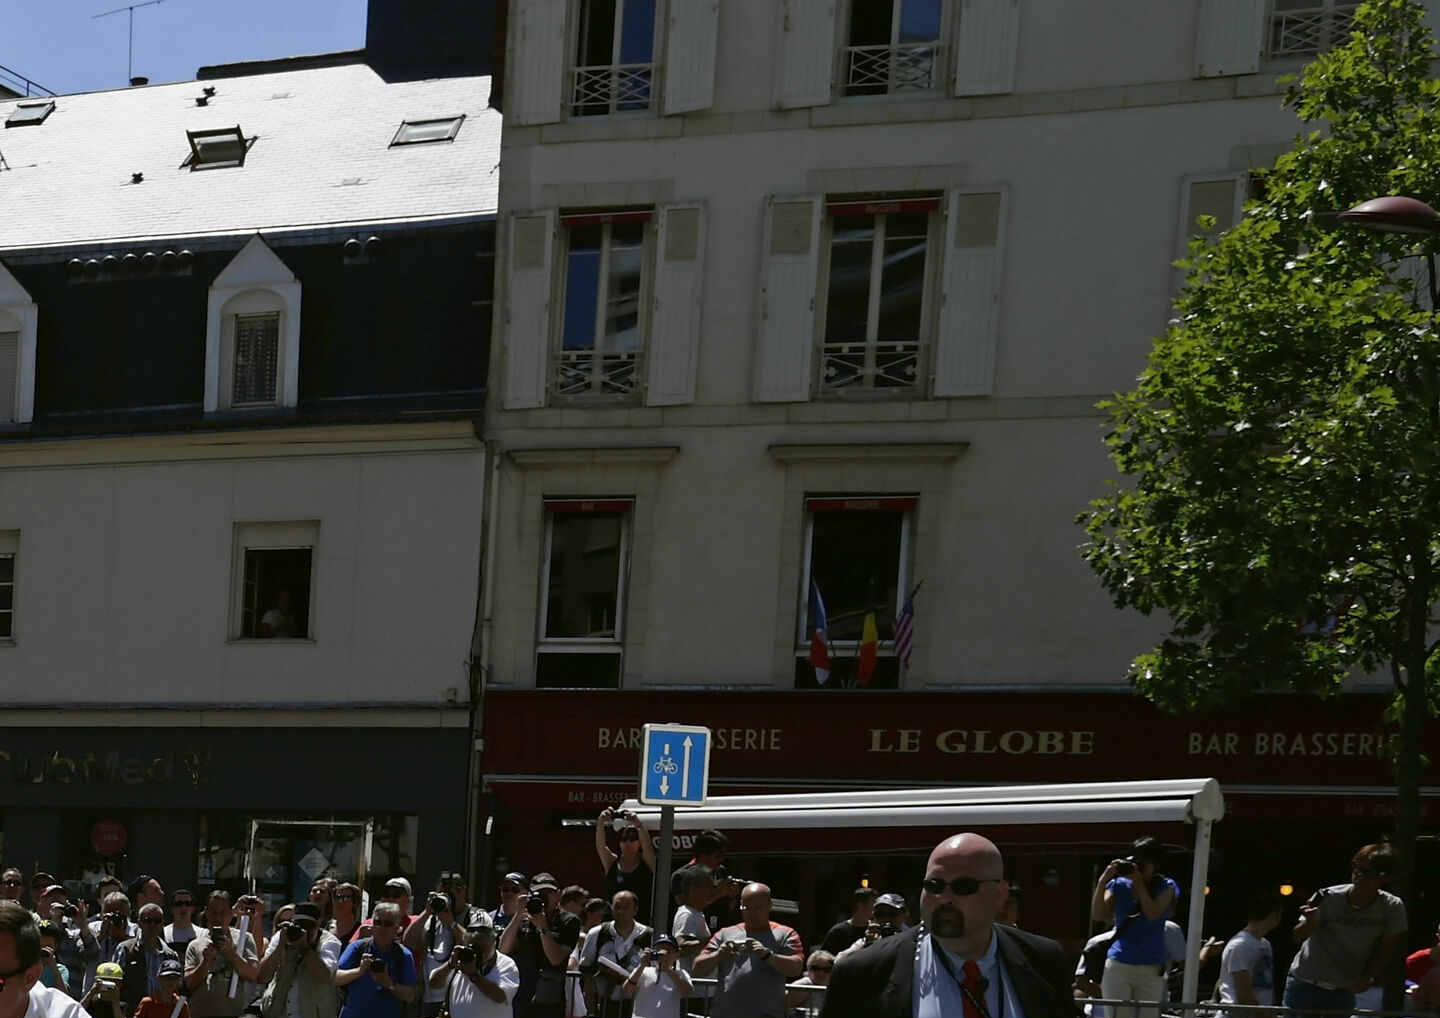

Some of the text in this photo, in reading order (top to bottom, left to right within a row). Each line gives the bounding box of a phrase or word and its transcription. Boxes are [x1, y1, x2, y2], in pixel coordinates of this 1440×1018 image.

[598, 728, 782, 751] BAR SSERIE
[867, 729, 1095, 755] LE GLOBE
[1188, 731, 1239, 755] BAR
[568, 791, 585, 803] BAR
[652, 835, 698, 850] GOB
